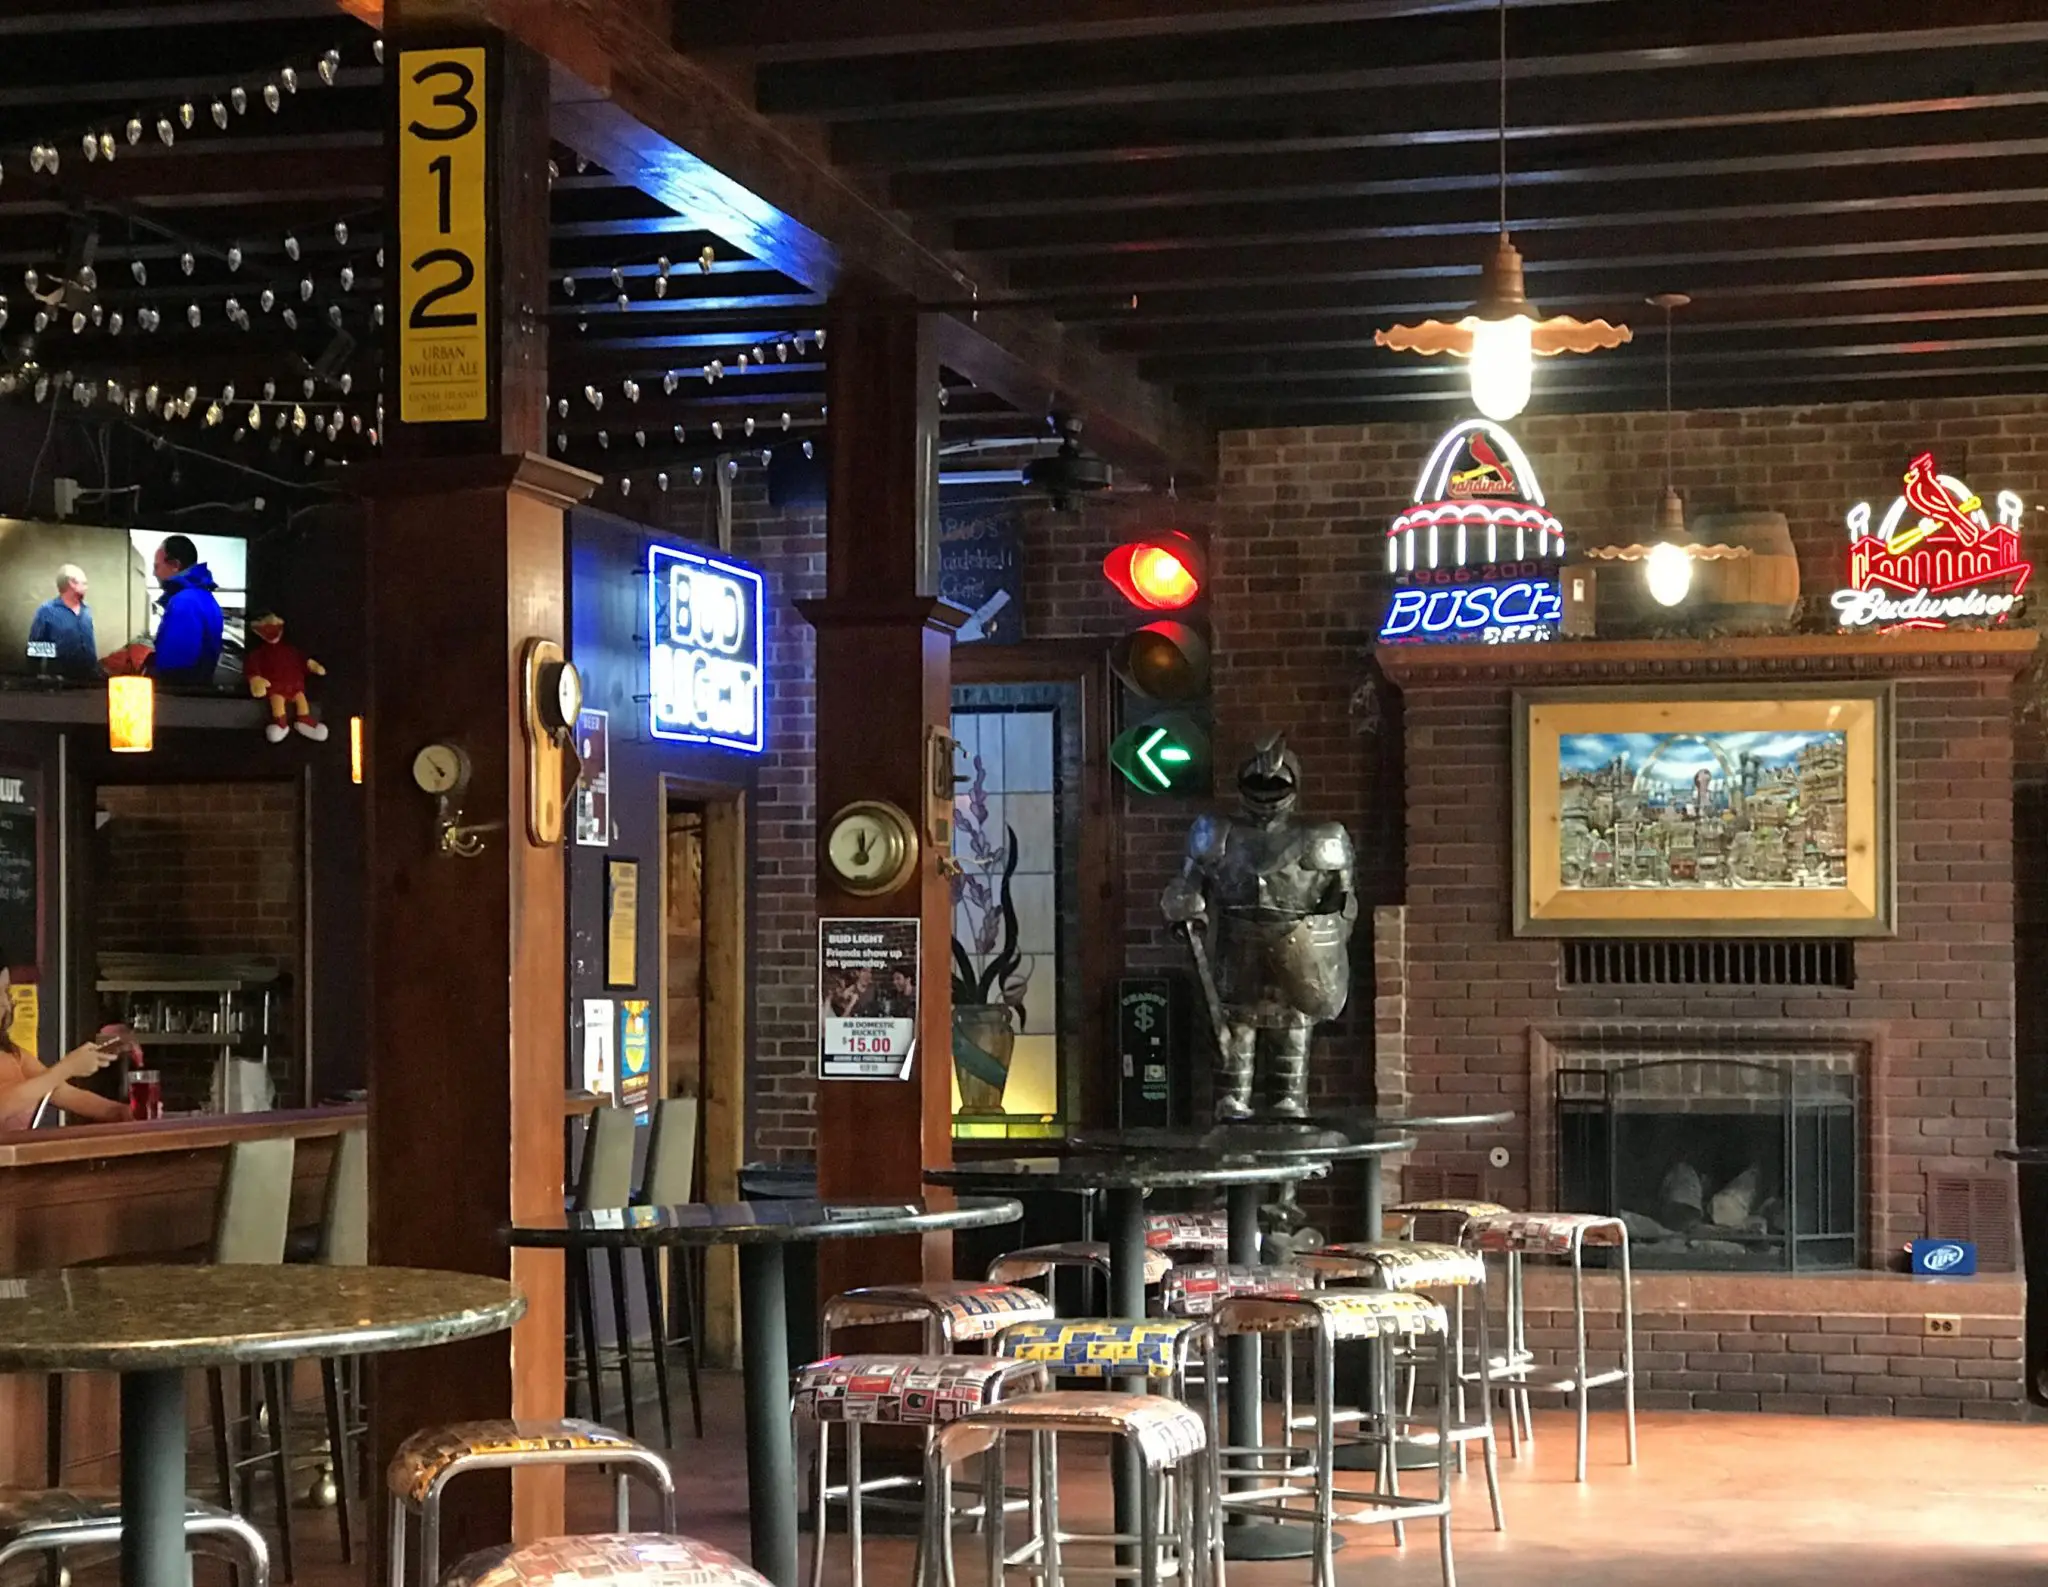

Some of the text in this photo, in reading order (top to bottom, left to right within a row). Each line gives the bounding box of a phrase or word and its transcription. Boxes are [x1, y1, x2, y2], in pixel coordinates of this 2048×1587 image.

[407, 60, 478, 329] 312
[421, 345, 466, 360] URBAN
[409, 361, 479, 377] WHEAT ALE
[670, 564, 745, 655] BUD
[1381, 582, 1561, 636] BUSCH
[1831, 587, 2024, 626] Budweiser
[1483, 624, 1551, 645] BEER
[828, 934, 884, 944] BUD LIGHT
[826, 948, 903, 960] Friends show up
[826, 959, 887, 970] on gameday.
[855, 1021, 895, 1029] DOMESTIC
[842, 1036, 891, 1053] $15.00
